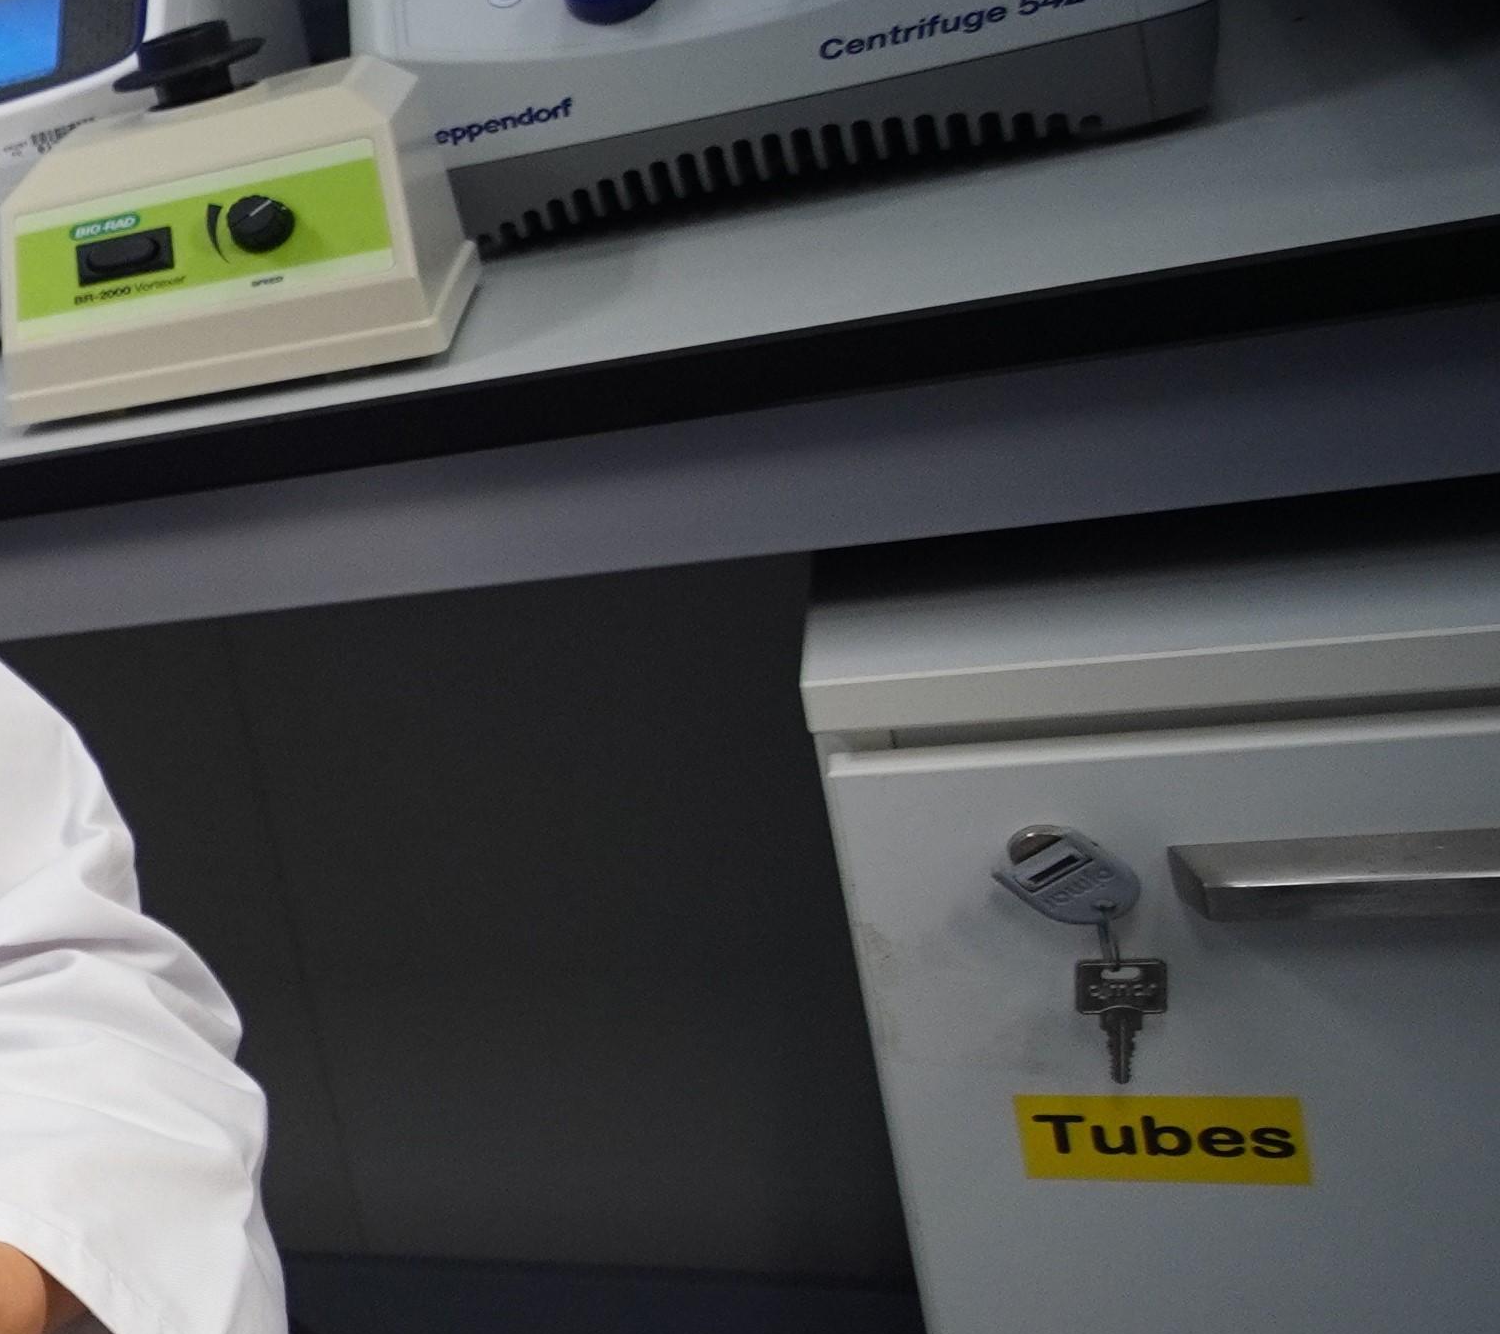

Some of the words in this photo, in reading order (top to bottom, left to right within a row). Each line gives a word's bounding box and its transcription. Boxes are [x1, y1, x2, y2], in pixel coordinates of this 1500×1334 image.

[818, 3, 1008, 62] Centrifuge
[434, 97, 574, 147] eppendorf
[74, 214, 137, 239] BIO-RAD
[73, 285, 132, 306] BR-2000
[136, 274, 187, 294] Vortexer
[1031, 1114, 1297, 1160] Tubes
